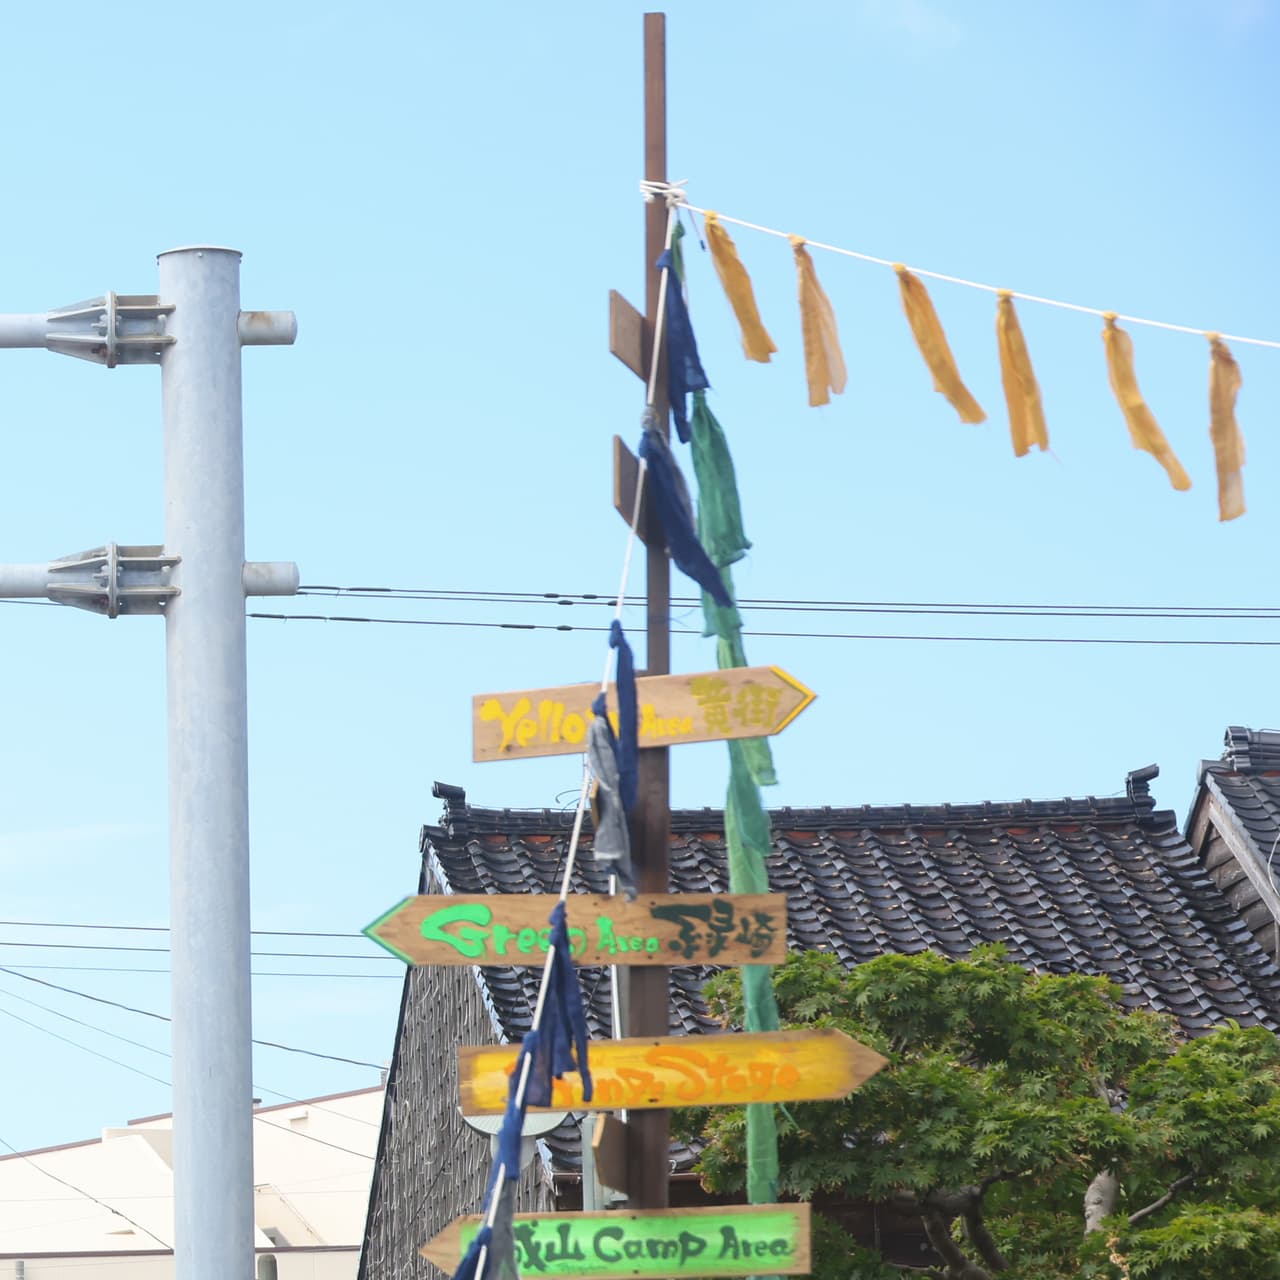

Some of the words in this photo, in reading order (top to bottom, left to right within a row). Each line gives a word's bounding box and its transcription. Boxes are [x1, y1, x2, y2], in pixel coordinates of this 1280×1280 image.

[638, 703, 694, 740] Area
[595, 916, 660, 955] Area
[645, 1046, 800, 1102] Stage
[593, 1225, 708, 1269] Camp
[719, 1224, 792, 1259] Area
